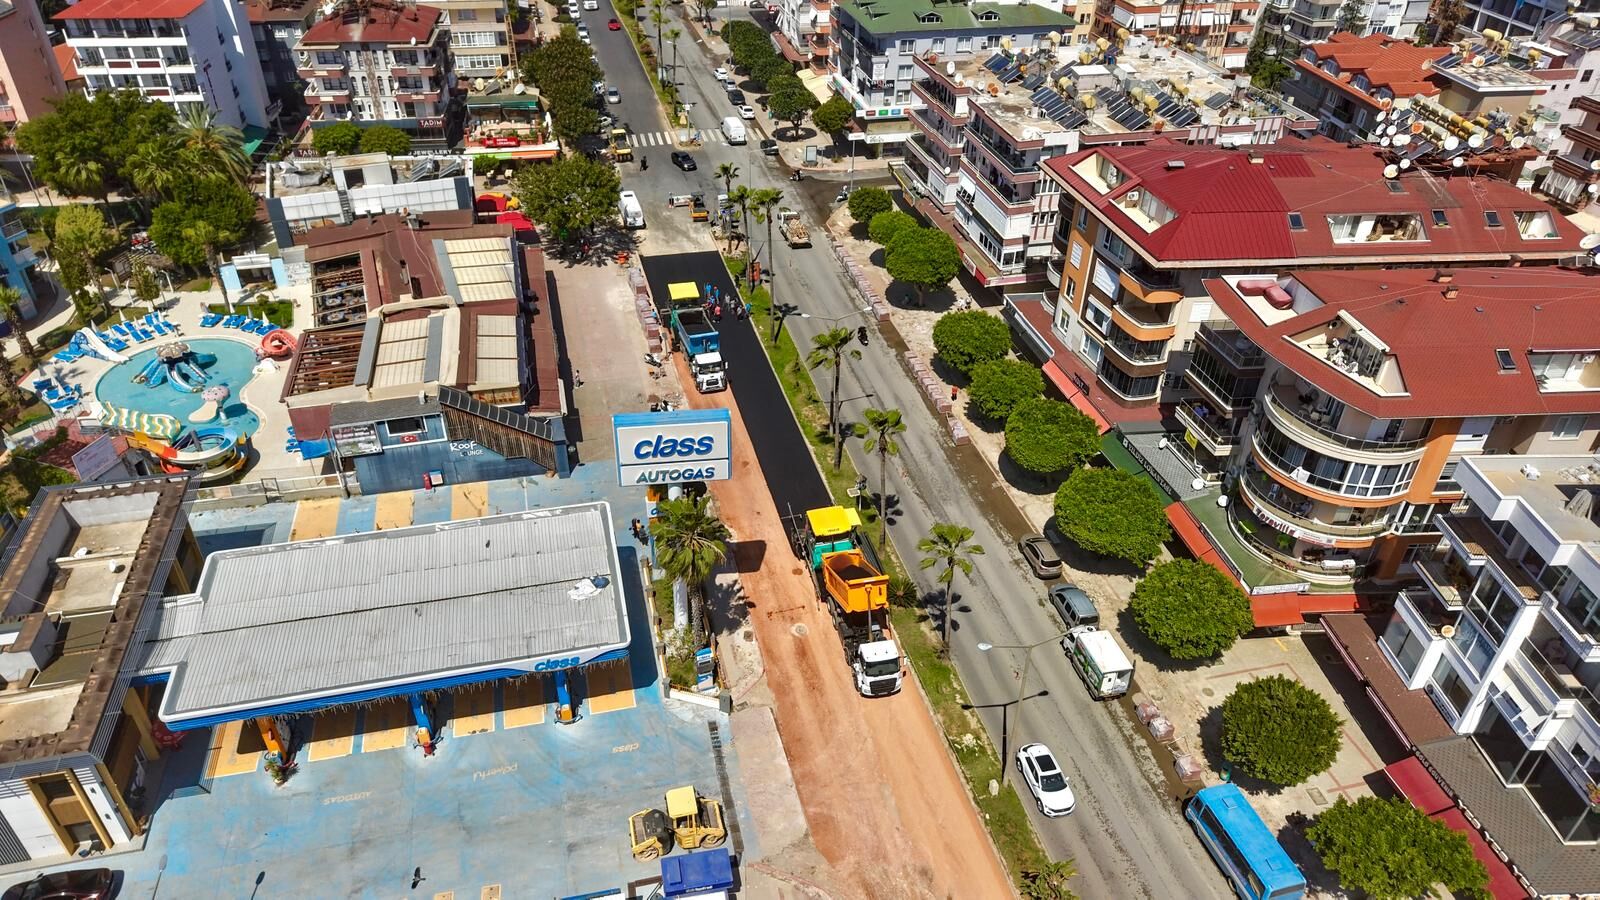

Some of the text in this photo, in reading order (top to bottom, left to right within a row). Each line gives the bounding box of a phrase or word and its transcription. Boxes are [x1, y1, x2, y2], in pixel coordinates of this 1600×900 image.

[633, 434, 715, 460] class
[635, 466, 716, 484] AUTOGAS
[534, 656, 580, 672] class
